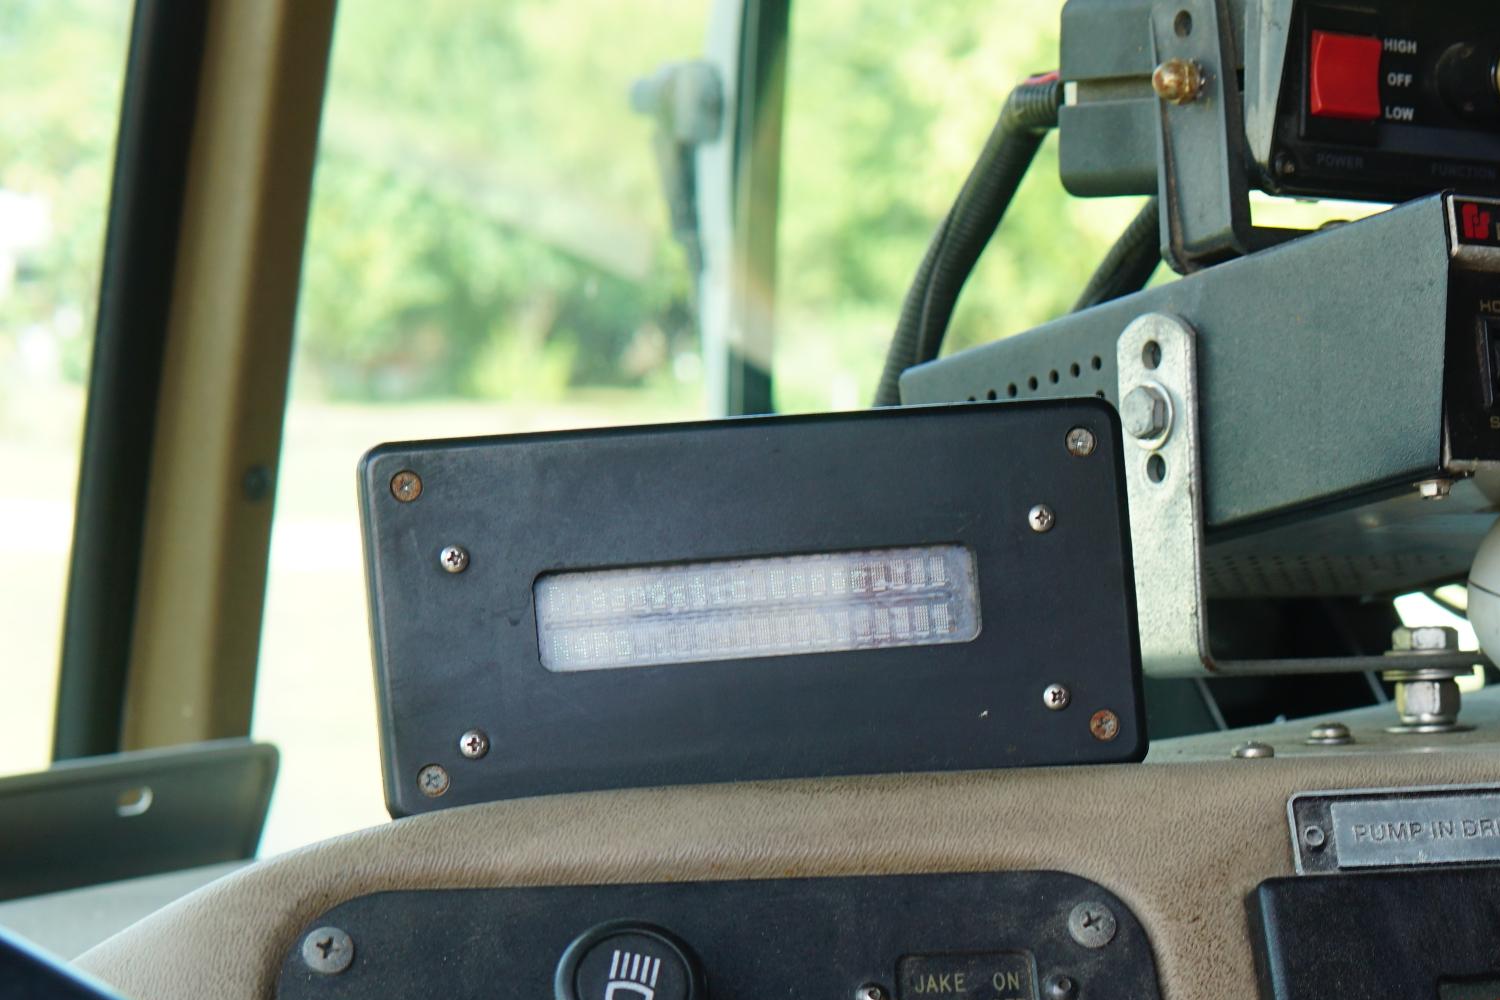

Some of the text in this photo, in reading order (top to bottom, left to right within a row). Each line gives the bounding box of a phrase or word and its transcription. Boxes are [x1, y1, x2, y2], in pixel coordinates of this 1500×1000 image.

[1384, 38, 1417, 55] HIGH
[1387, 73, 1413, 88] OFF
[1384, 105, 1415, 122] LOW
[1316, 152, 1364, 169] POWER
[1430, 162, 1496, 180] FUNCTION
[1352, 821, 1424, 842] PUMP
[1431, 820, 1456, 839] IN
[914, 971, 1020, 994] JAKE ON
